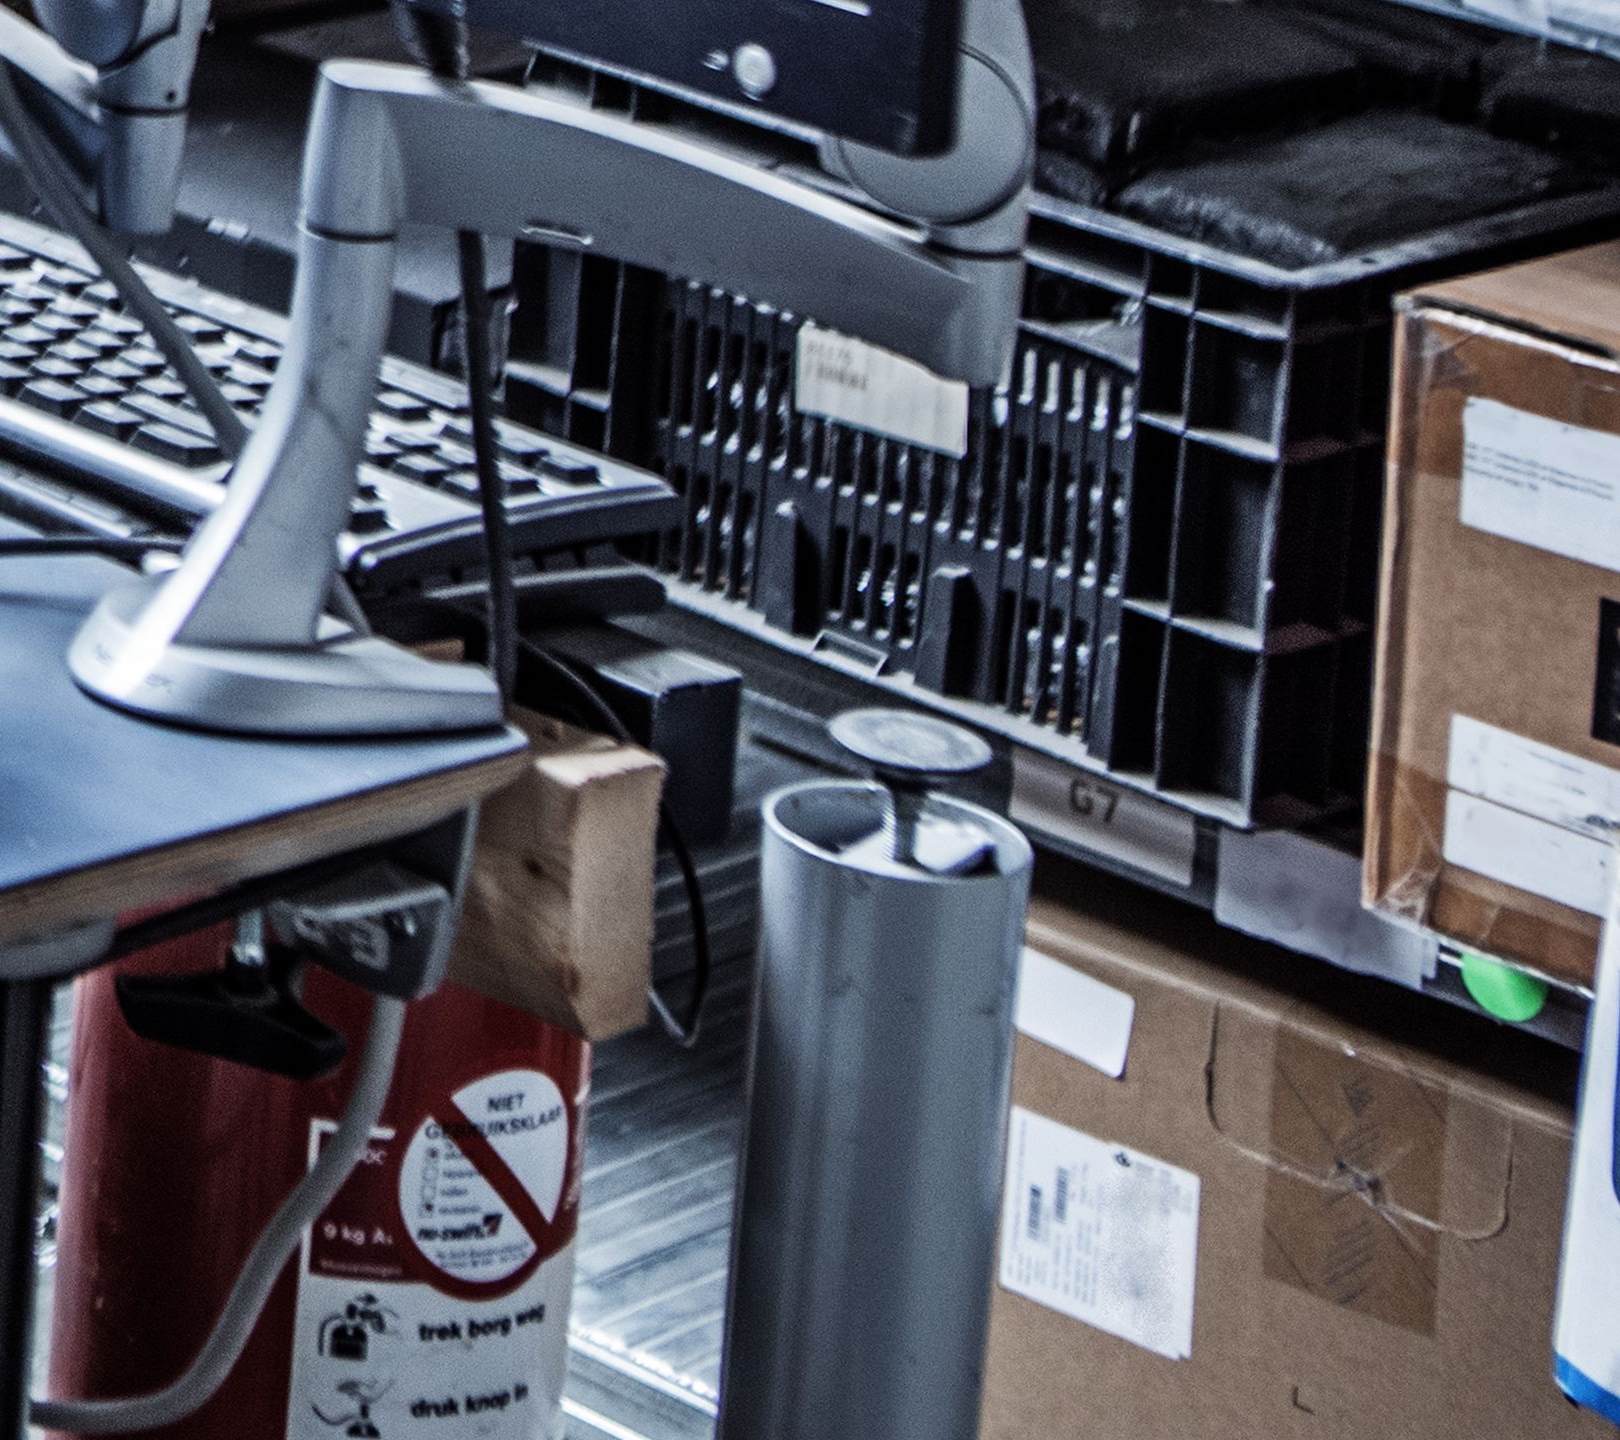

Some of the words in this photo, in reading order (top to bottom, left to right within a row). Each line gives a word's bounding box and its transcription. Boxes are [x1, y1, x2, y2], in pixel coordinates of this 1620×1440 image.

[1070, 776, 1120, 824] G7
[487, 1092, 526, 1113] NIET
[425, 1104, 564, 1140] GUIKSKLAAR
[419, 1323, 462, 1342] trek
[467, 1316, 512, 1338] borg
[410, 1397, 460, 1419] druk
[465, 1390, 511, 1414] knop
